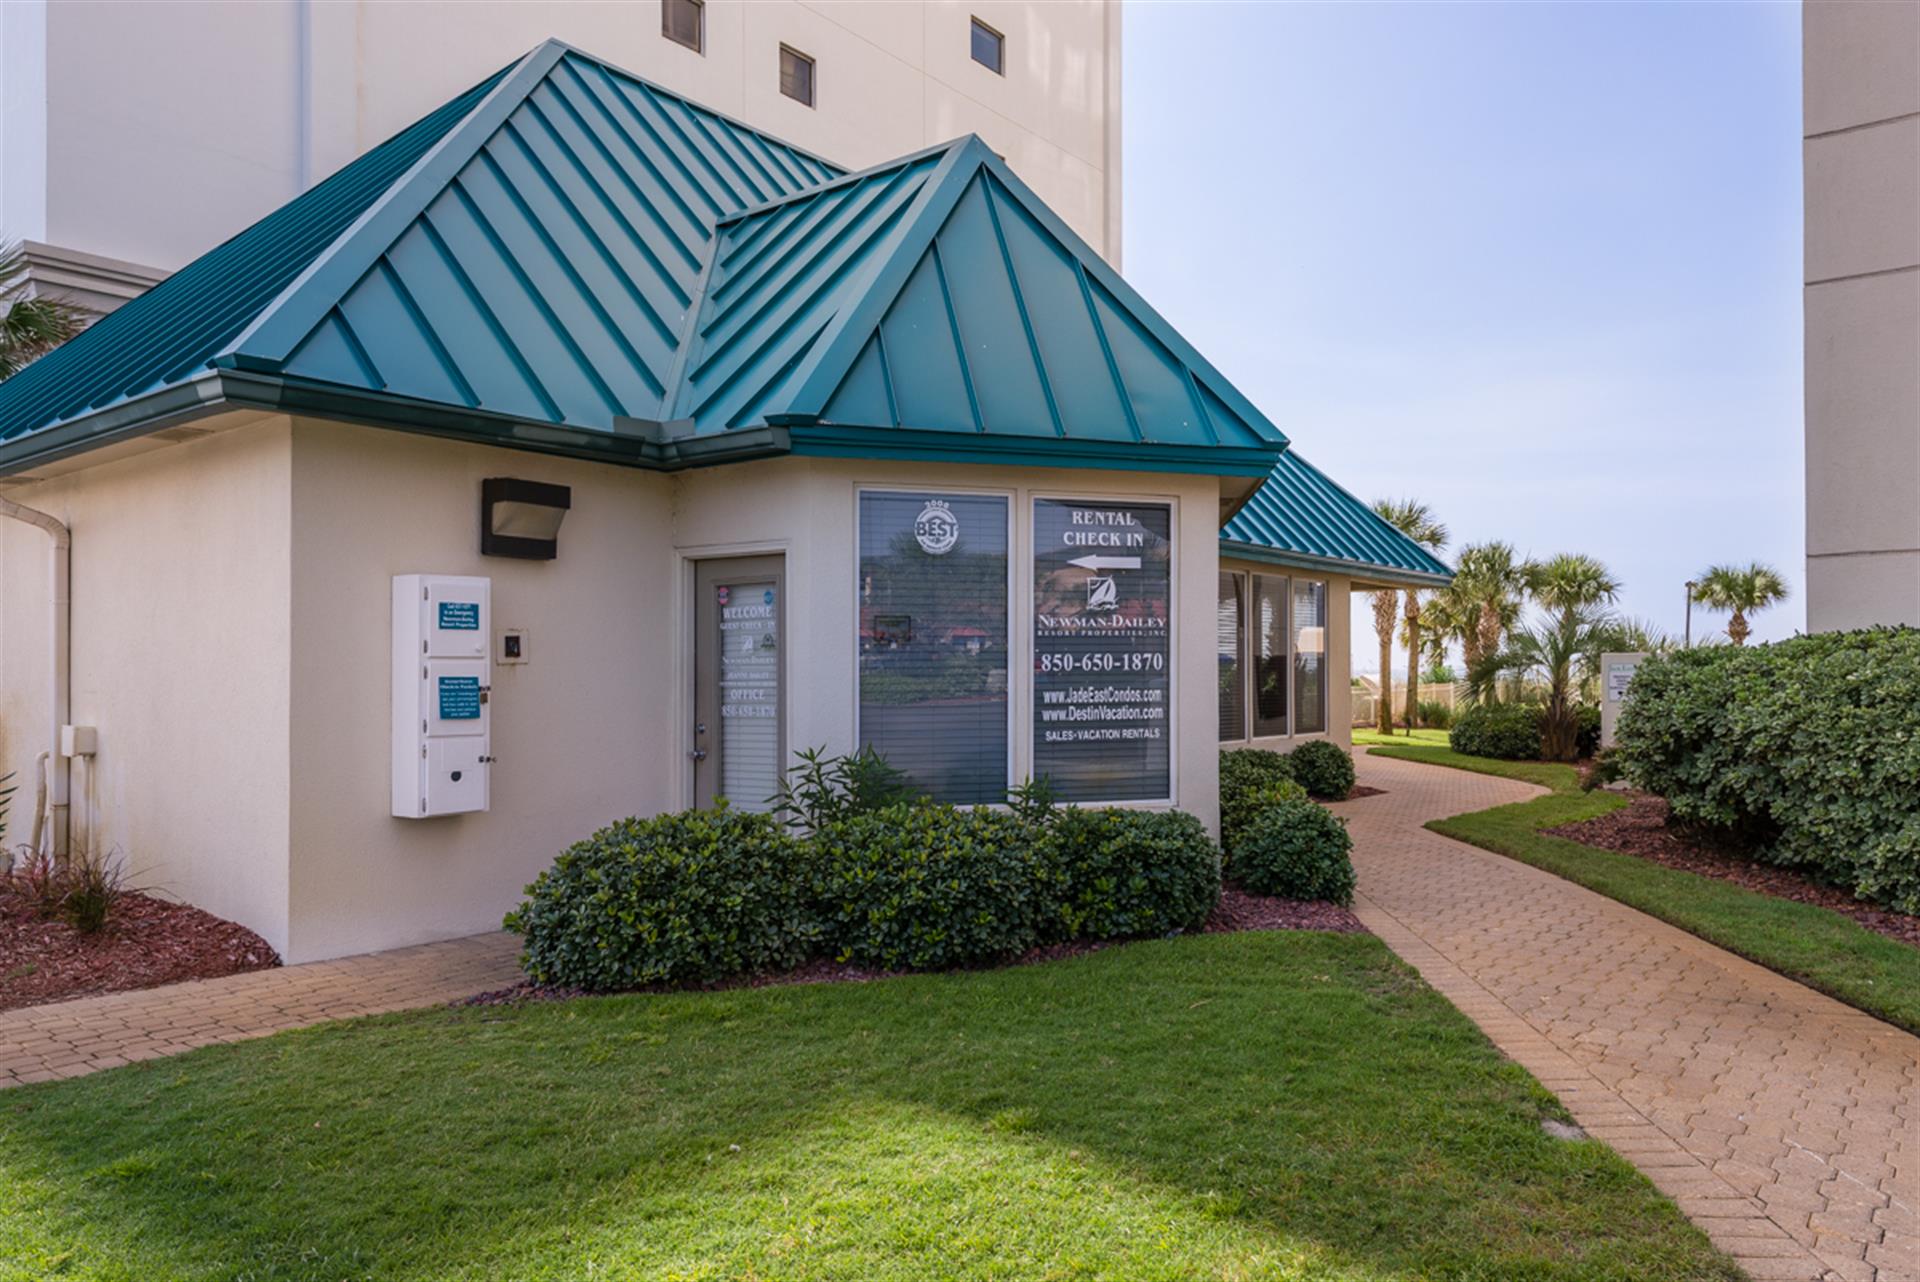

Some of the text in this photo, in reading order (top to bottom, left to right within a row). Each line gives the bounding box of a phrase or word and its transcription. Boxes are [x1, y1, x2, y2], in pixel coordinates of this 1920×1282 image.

[1072, 511, 1136, 526] RENTAL
[916, 521, 957, 537] BEST
[1063, 531, 1144, 547] CHECK IN
[723, 606, 772, 618] WELCOME
[1038, 614, 1167, 628] NEWMAN-DAILEY
[1041, 652, 1163, 671] 850-650-1870
[730, 689, 766, 700] OFFICE
[1042, 686, 1162, 703] www.JadeEastCondos.com
[1041, 705, 1164, 721] www.DestinVacation.com
[1122, 727, 1161, 739] RENTALS
